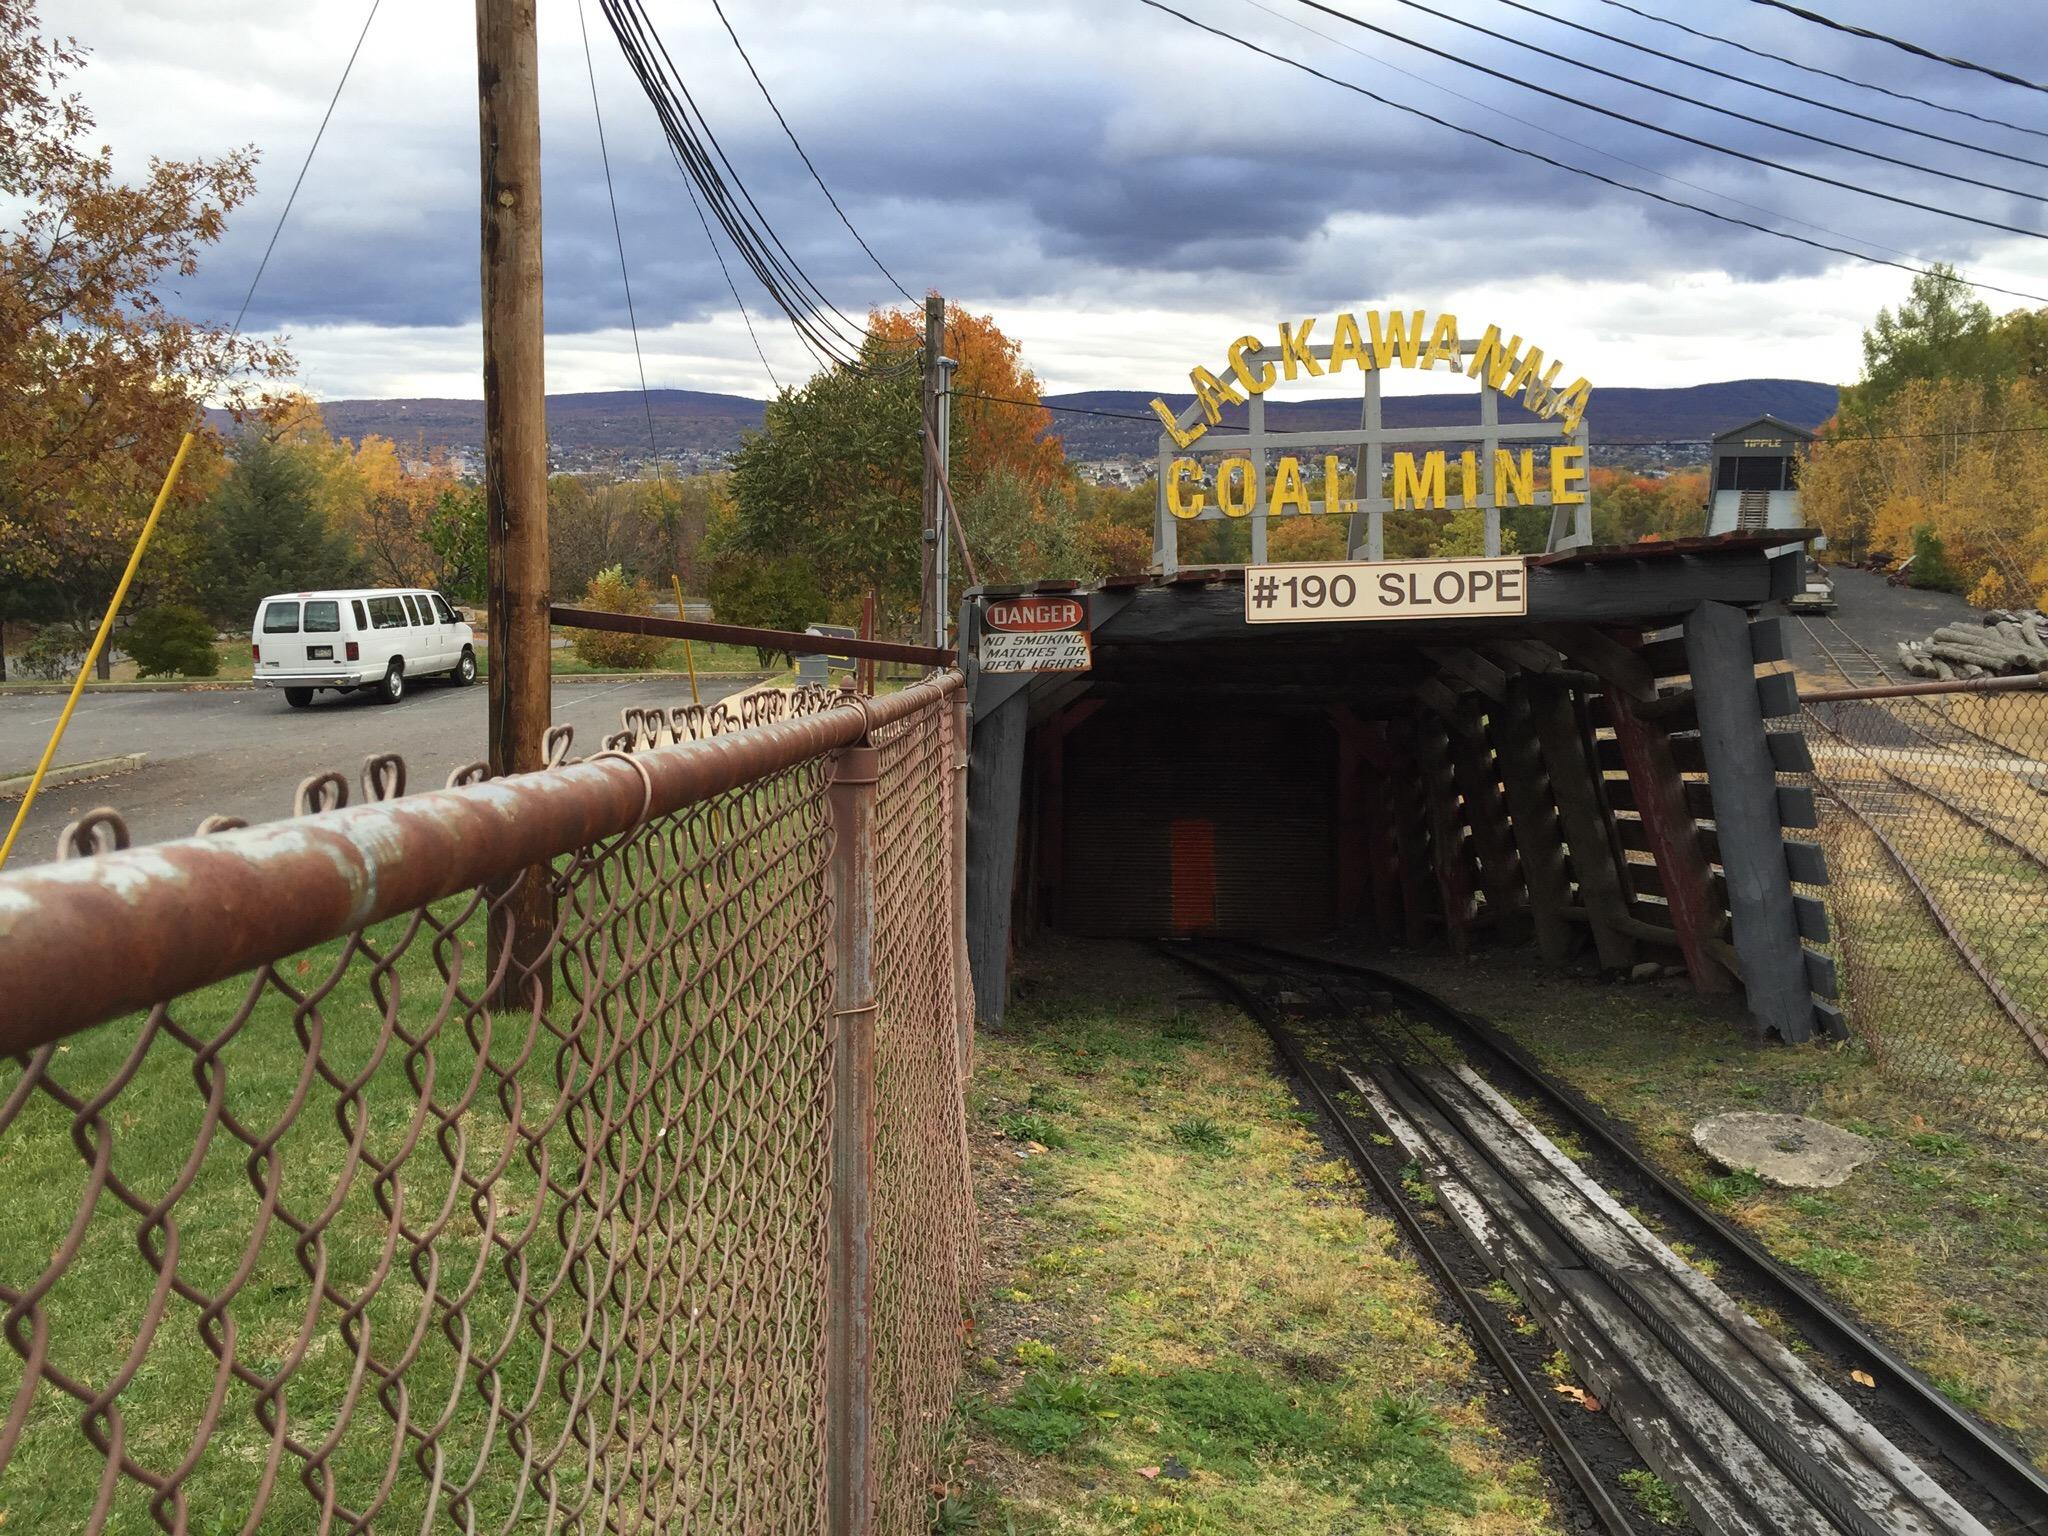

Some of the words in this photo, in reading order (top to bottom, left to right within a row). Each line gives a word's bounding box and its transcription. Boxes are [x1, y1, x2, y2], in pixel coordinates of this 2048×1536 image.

[1149, 310, 1593, 449] LACKAWANNA
[1744, 439, 1782, 448] TIPPLE
[1167, 455, 1358, 519] COAL
[1393, 445, 1586, 511] MINE
[1252, 574, 1357, 609] #190
[1378, 569, 1522, 607] SLOPE
[993, 605, 1077, 625] DANGER
[984, 636, 1006, 647] NO
[986, 647, 1058, 659] MATCHES
[1064, 646, 1087, 656] OR
[984, 660, 1026, 671] OPEN
[1031, 658, 1086, 670] LIGHTS
